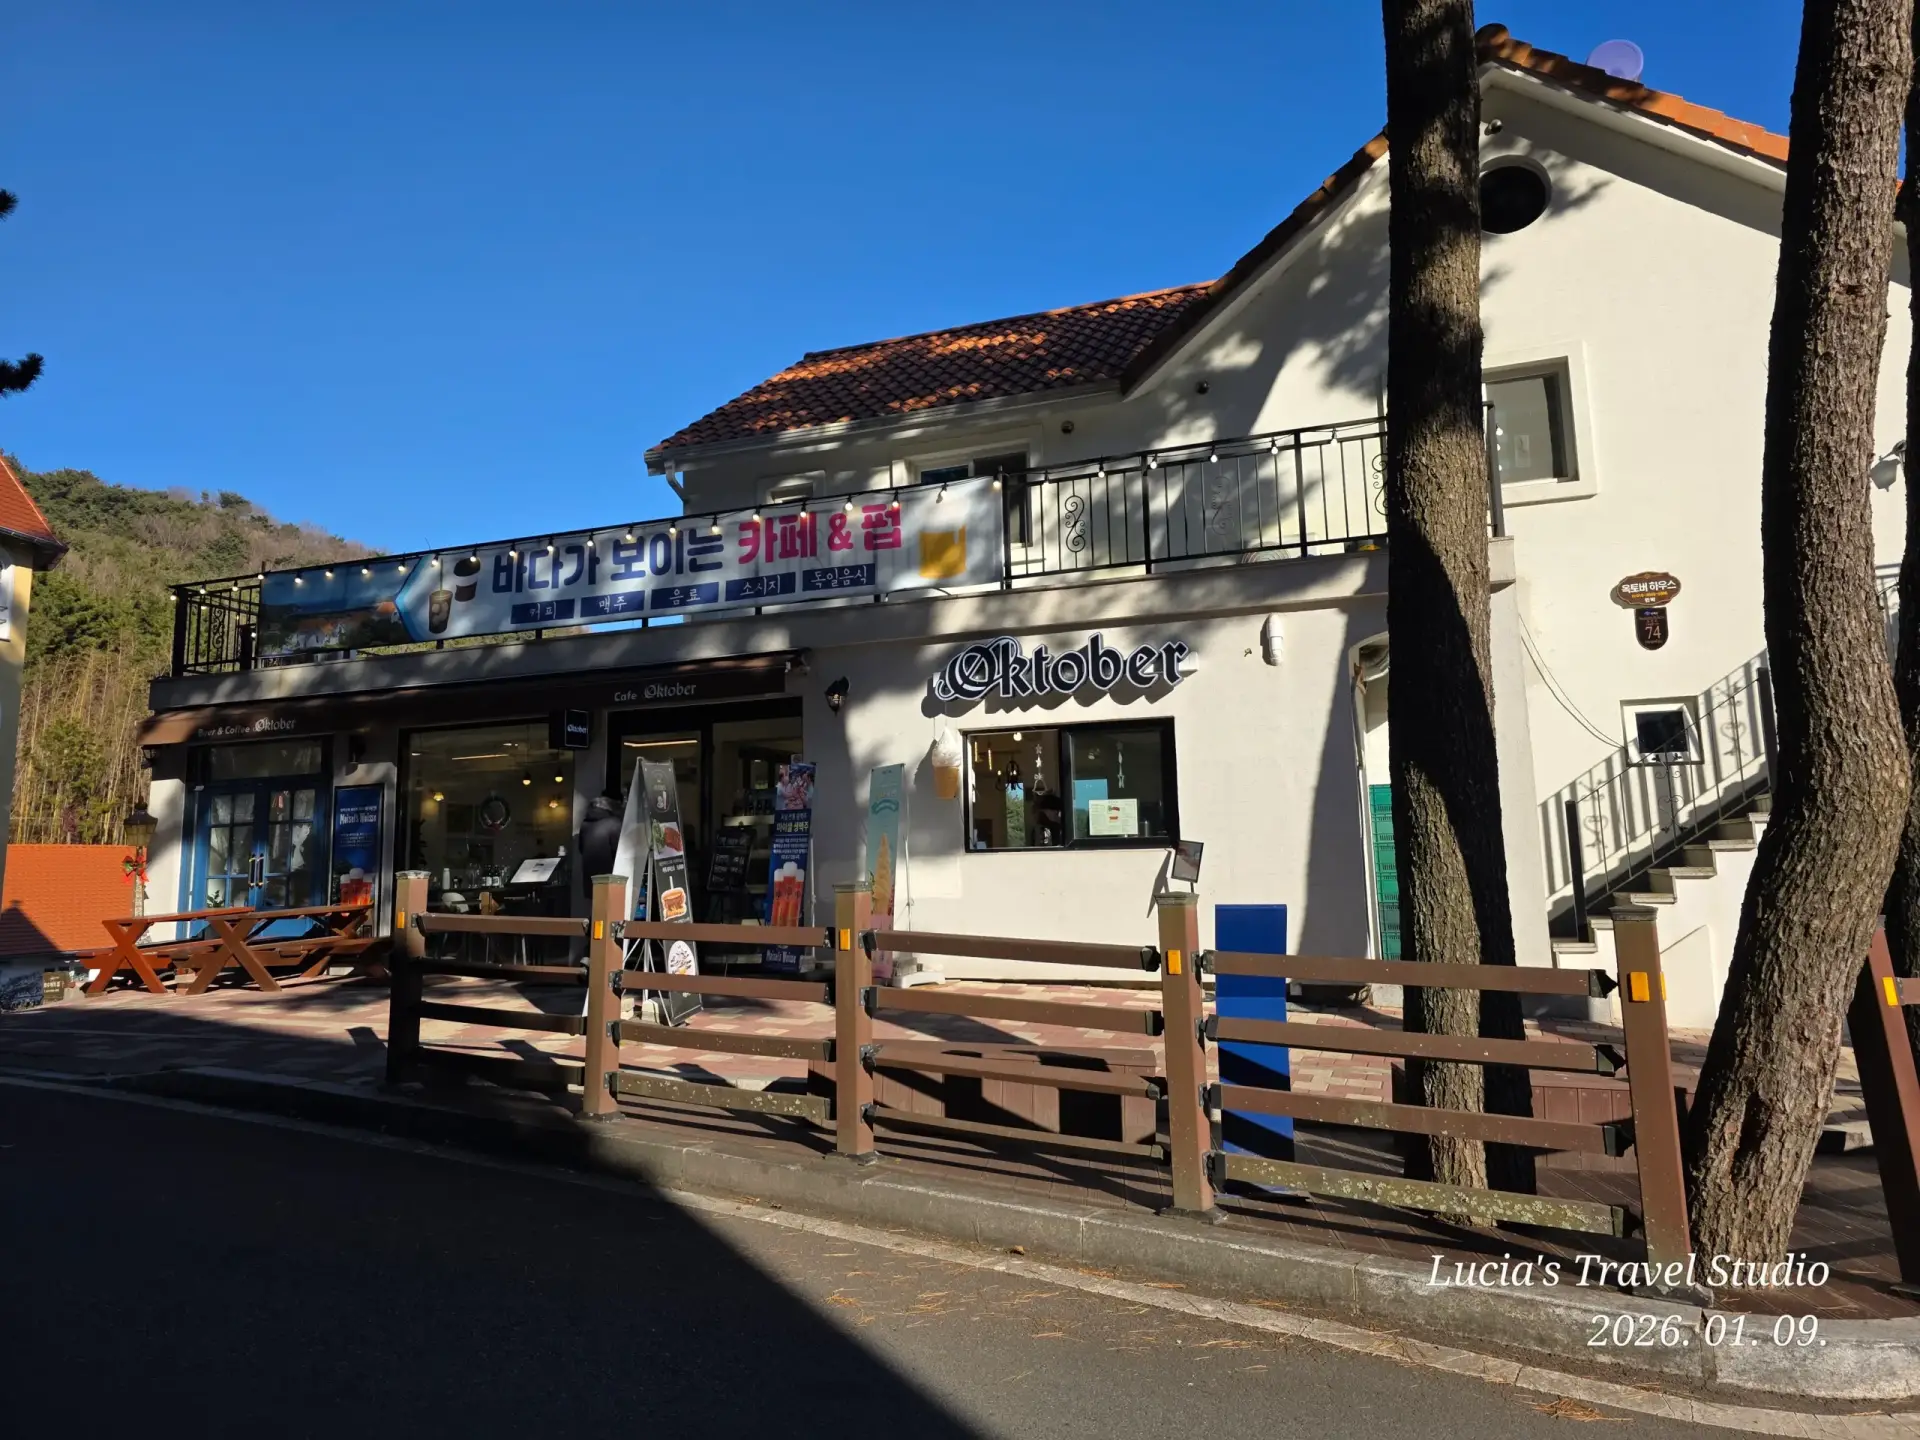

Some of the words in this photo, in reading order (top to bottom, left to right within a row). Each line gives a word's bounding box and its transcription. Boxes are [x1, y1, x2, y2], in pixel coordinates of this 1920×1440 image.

[492, 542, 600, 593] 바다가
[610, 527, 724, 581] 보이는
[738, 511, 817, 565] 카페
[827, 513, 853, 552] &
[861, 503, 902, 551] 펍
[739, 575, 781, 597] 소시지
[809, 565, 868, 588] 독일음식
[1621, 582, 1648, 594] 옥토버
[1649, 580, 1677, 591] 하우스
[598, 595, 628, 615] 맥주
[669, 588, 701, 607] 음료
[530, 601, 556, 619] 커피
[1645, 626, 1661, 640] 74
[933, 632, 1189, 701] Oktober
[614, 690, 638, 702] Cafe
[644, 682, 697, 699] Oktober
[252, 716, 297, 732] Oktober
